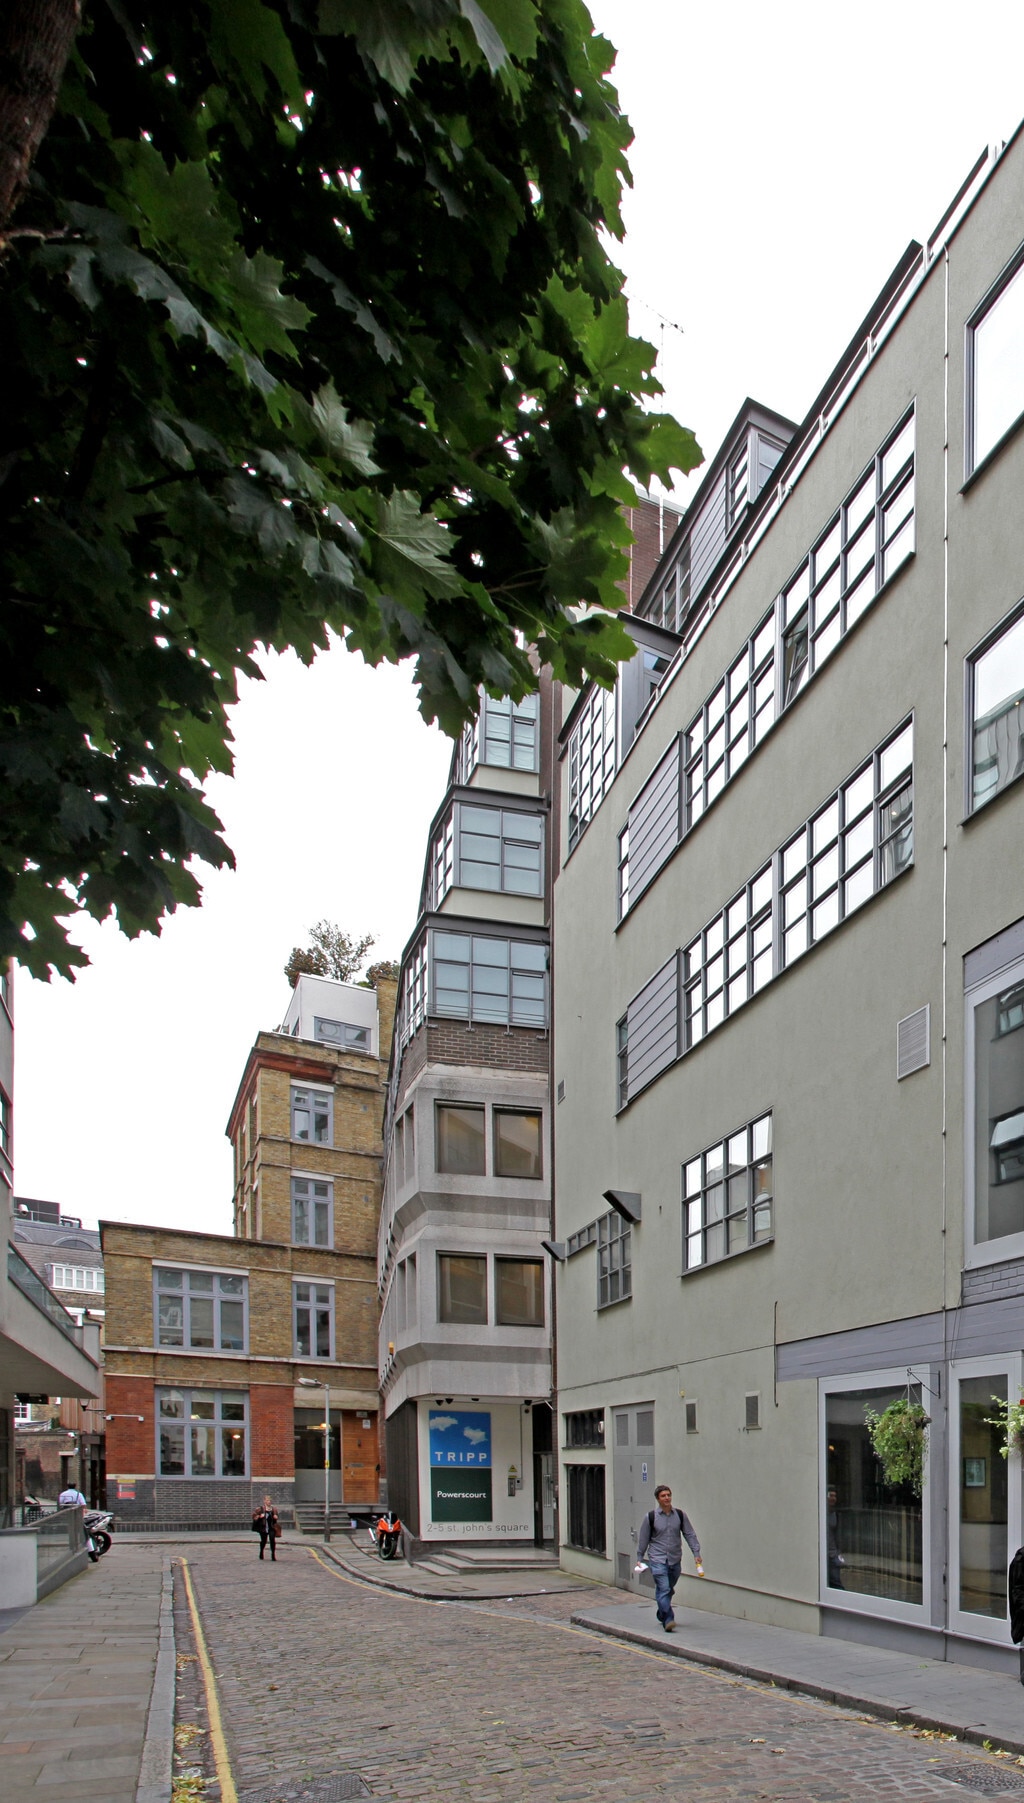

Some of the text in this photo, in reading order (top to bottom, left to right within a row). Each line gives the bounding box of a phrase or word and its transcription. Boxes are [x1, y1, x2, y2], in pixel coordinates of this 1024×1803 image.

[435, 1451, 487, 1462] TRIPP
[436, 1490, 486, 1499] Powerscourt
[427, 1522, 529, 1534] 2-5 st. john's square
